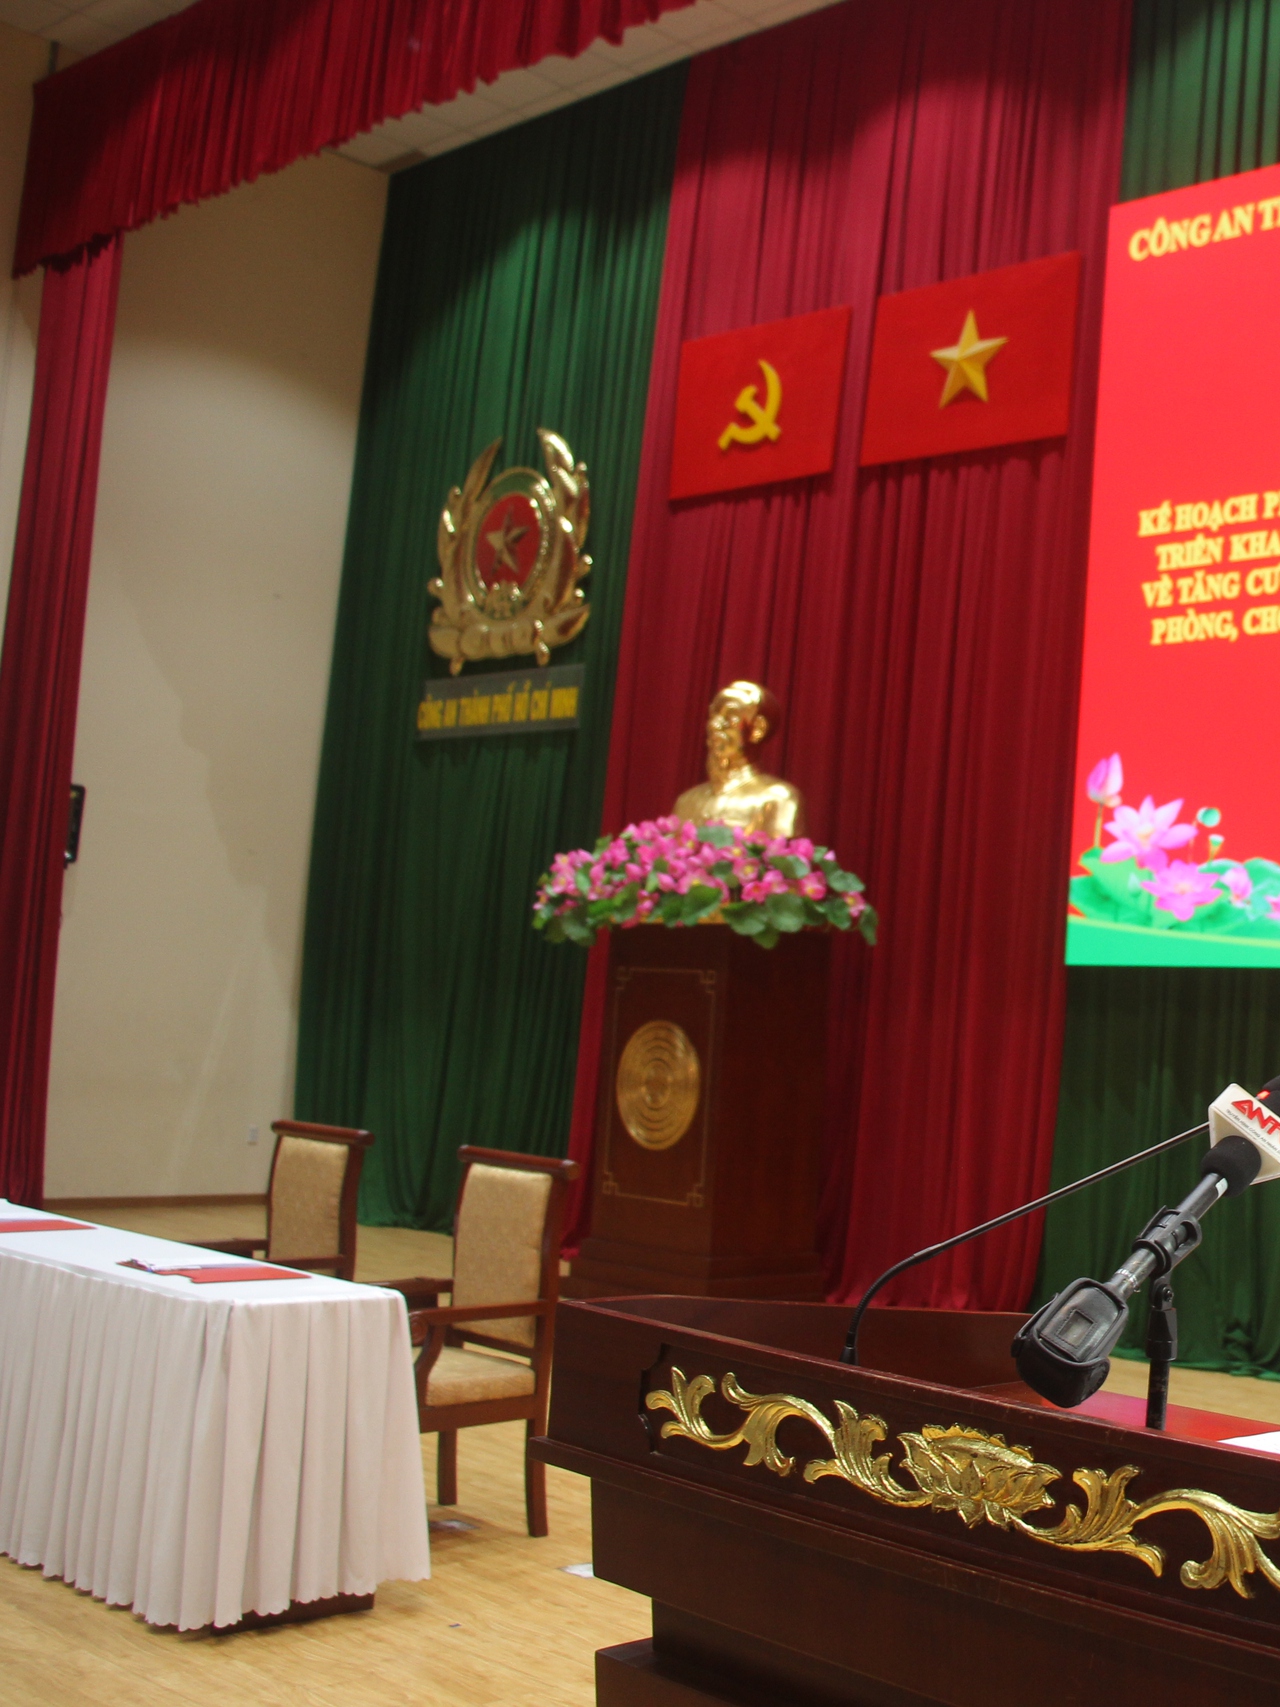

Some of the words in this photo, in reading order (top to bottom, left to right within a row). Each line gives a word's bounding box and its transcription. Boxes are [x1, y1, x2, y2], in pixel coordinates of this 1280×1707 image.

[1128, 215, 1212, 260] CÔNG
[1213, 204, 1255, 241] AN
[1138, 500, 1171, 537] KẾ
[1174, 493, 1259, 532] HOẠCH
[1141, 573, 1173, 608] VỀ
[1177, 569, 1240, 605] TĂNG
[1150, 609, 1239, 645] PHÒNG,
